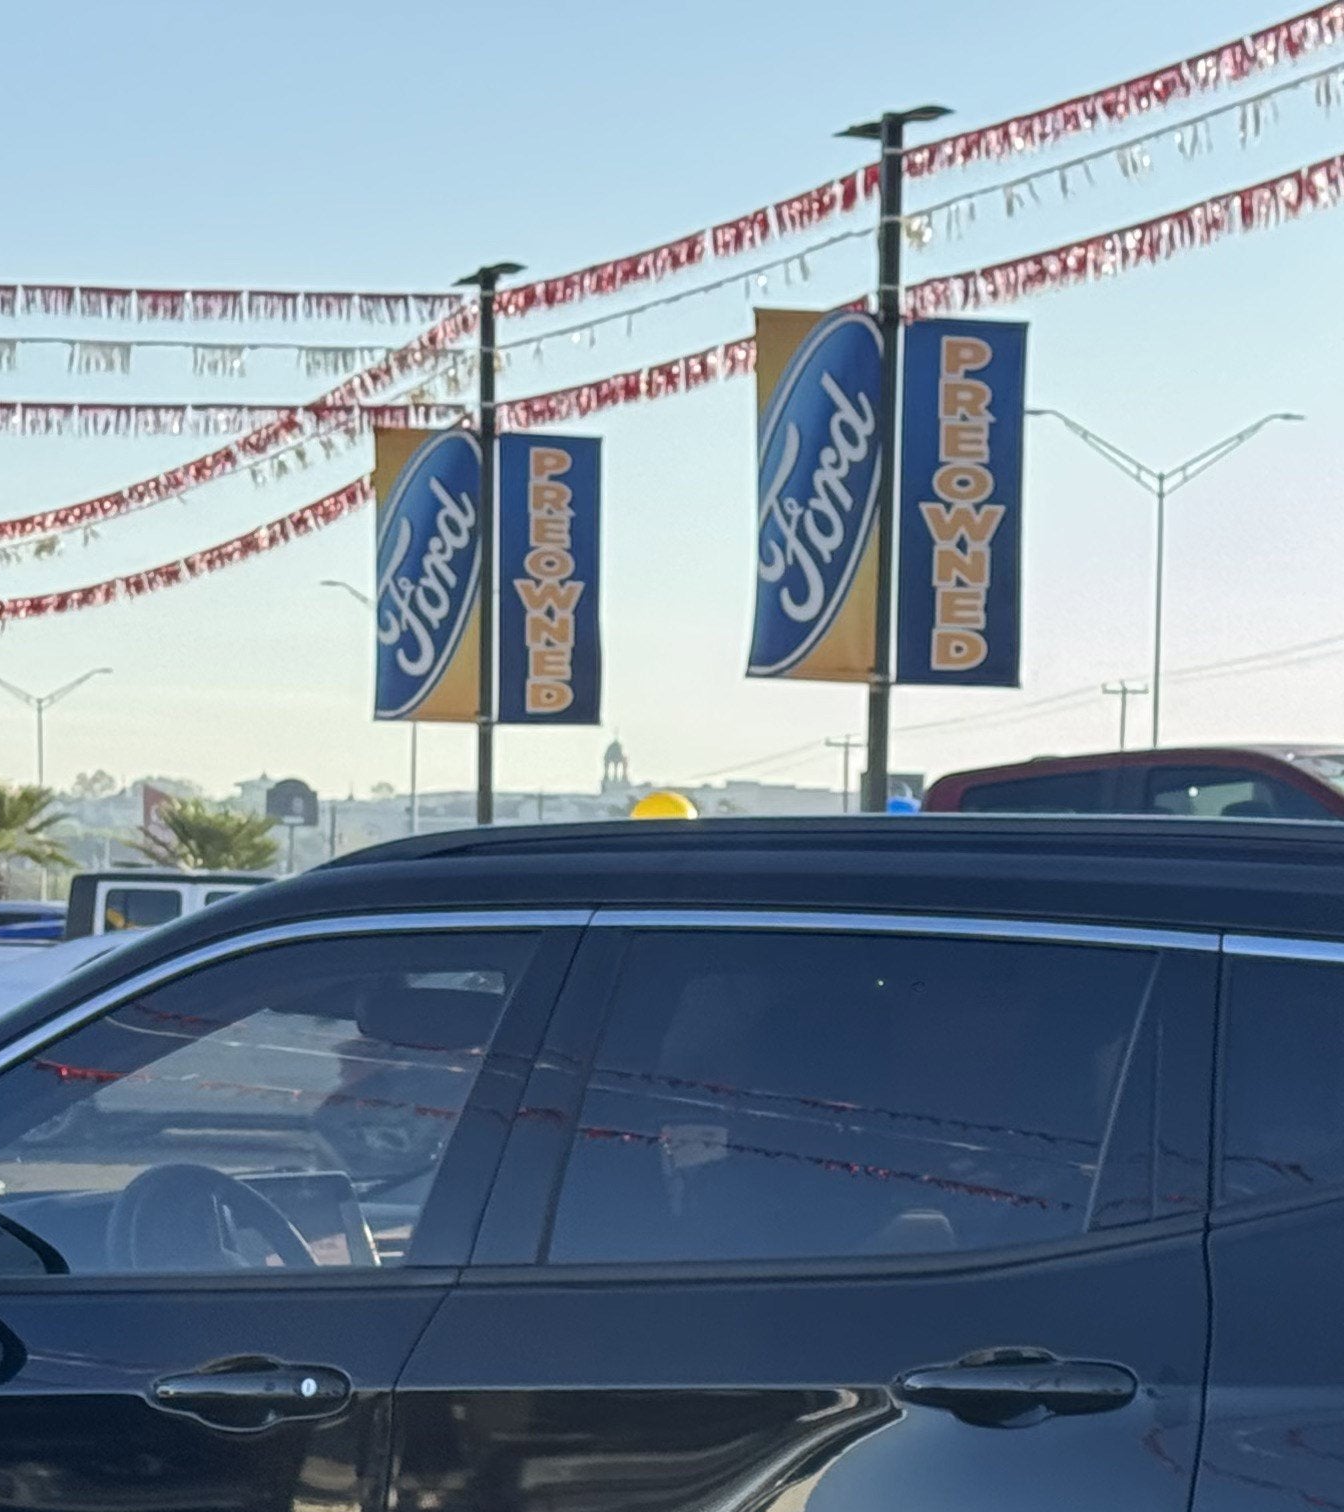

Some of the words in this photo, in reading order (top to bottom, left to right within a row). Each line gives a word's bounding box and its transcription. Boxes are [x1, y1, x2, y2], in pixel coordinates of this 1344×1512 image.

[377, 476, 476, 677] Ford
[513, 446, 586, 714] PREOWNED
[757, 372, 876, 623] Ford
[917, 336, 1006, 672] PREOWNED
